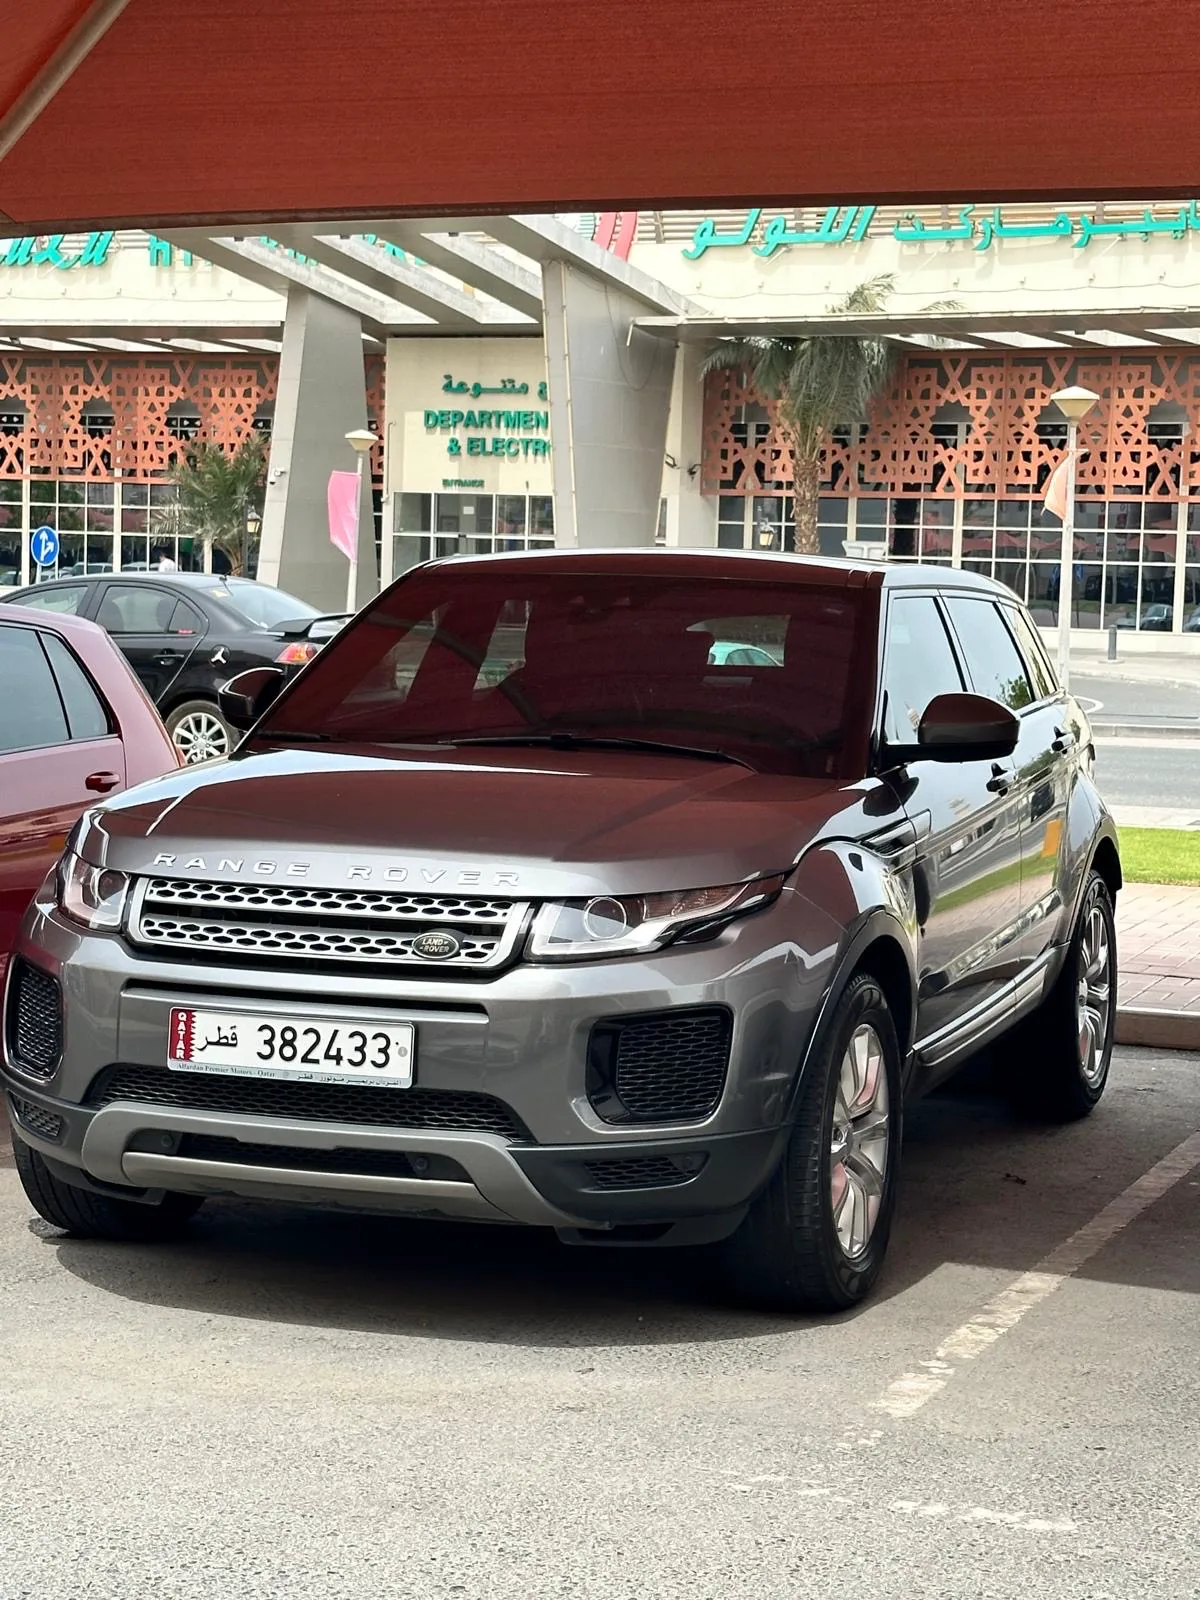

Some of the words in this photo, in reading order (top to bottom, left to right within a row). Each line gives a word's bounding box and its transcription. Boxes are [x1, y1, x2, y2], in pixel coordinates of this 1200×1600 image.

[893, 200, 1200, 250] ايبرماركت
[447, 437, 461, 456] &
[153, 852, 311, 877] RANGE
[346, 865, 520, 887] ROVER
[421, 937, 444, 946] LAND
[423, 945, 450, 953] ROVER
[175, 1011, 187, 1059] QATAR
[196, 1025, 238, 1051] قطر
[256, 1024, 391, 1069] 382433
[205, 1065, 229, 1073] Premier
[257, 1069, 275, 1078] Qatar
